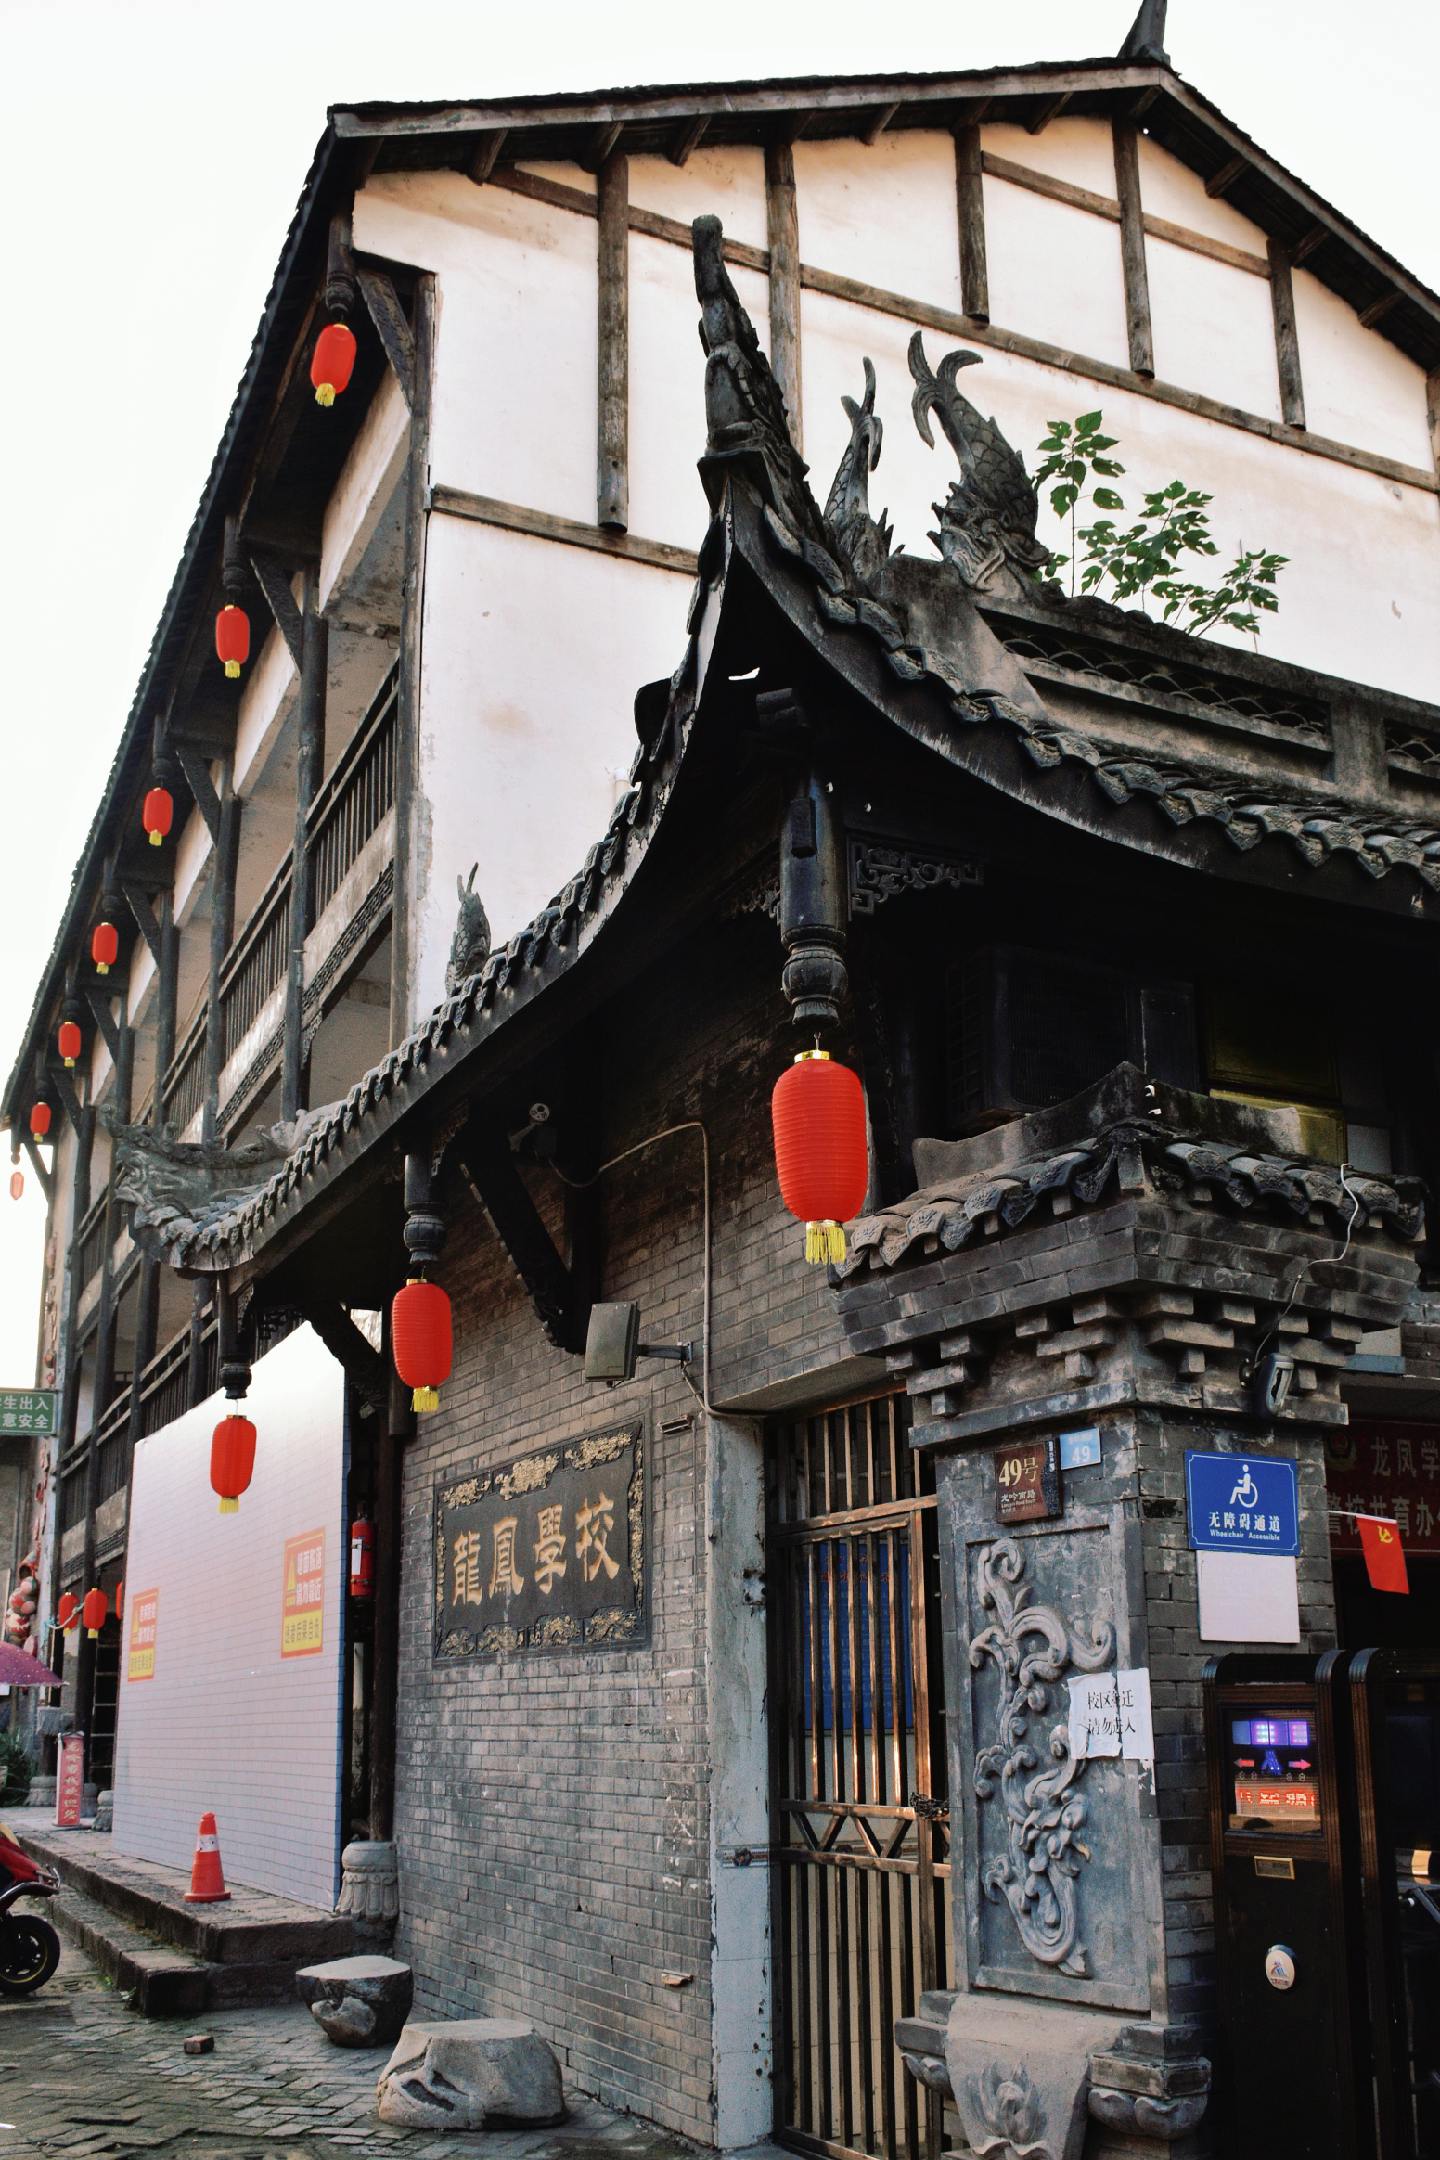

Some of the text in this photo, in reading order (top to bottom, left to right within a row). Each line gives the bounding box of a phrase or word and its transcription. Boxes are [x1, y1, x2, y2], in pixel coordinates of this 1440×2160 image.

[0, 1395, 49, 1410] 生出入
[1072, 1446, 1091, 1464] 49
[998, 1457, 1038, 1487] 49号
[1208, 1511, 1281, 1532] 无障碍通道
[1210, 1529, 1280, 1541] Wheelchair Accessible
[453, 1490, 620, 1606] 龍鳳學校
